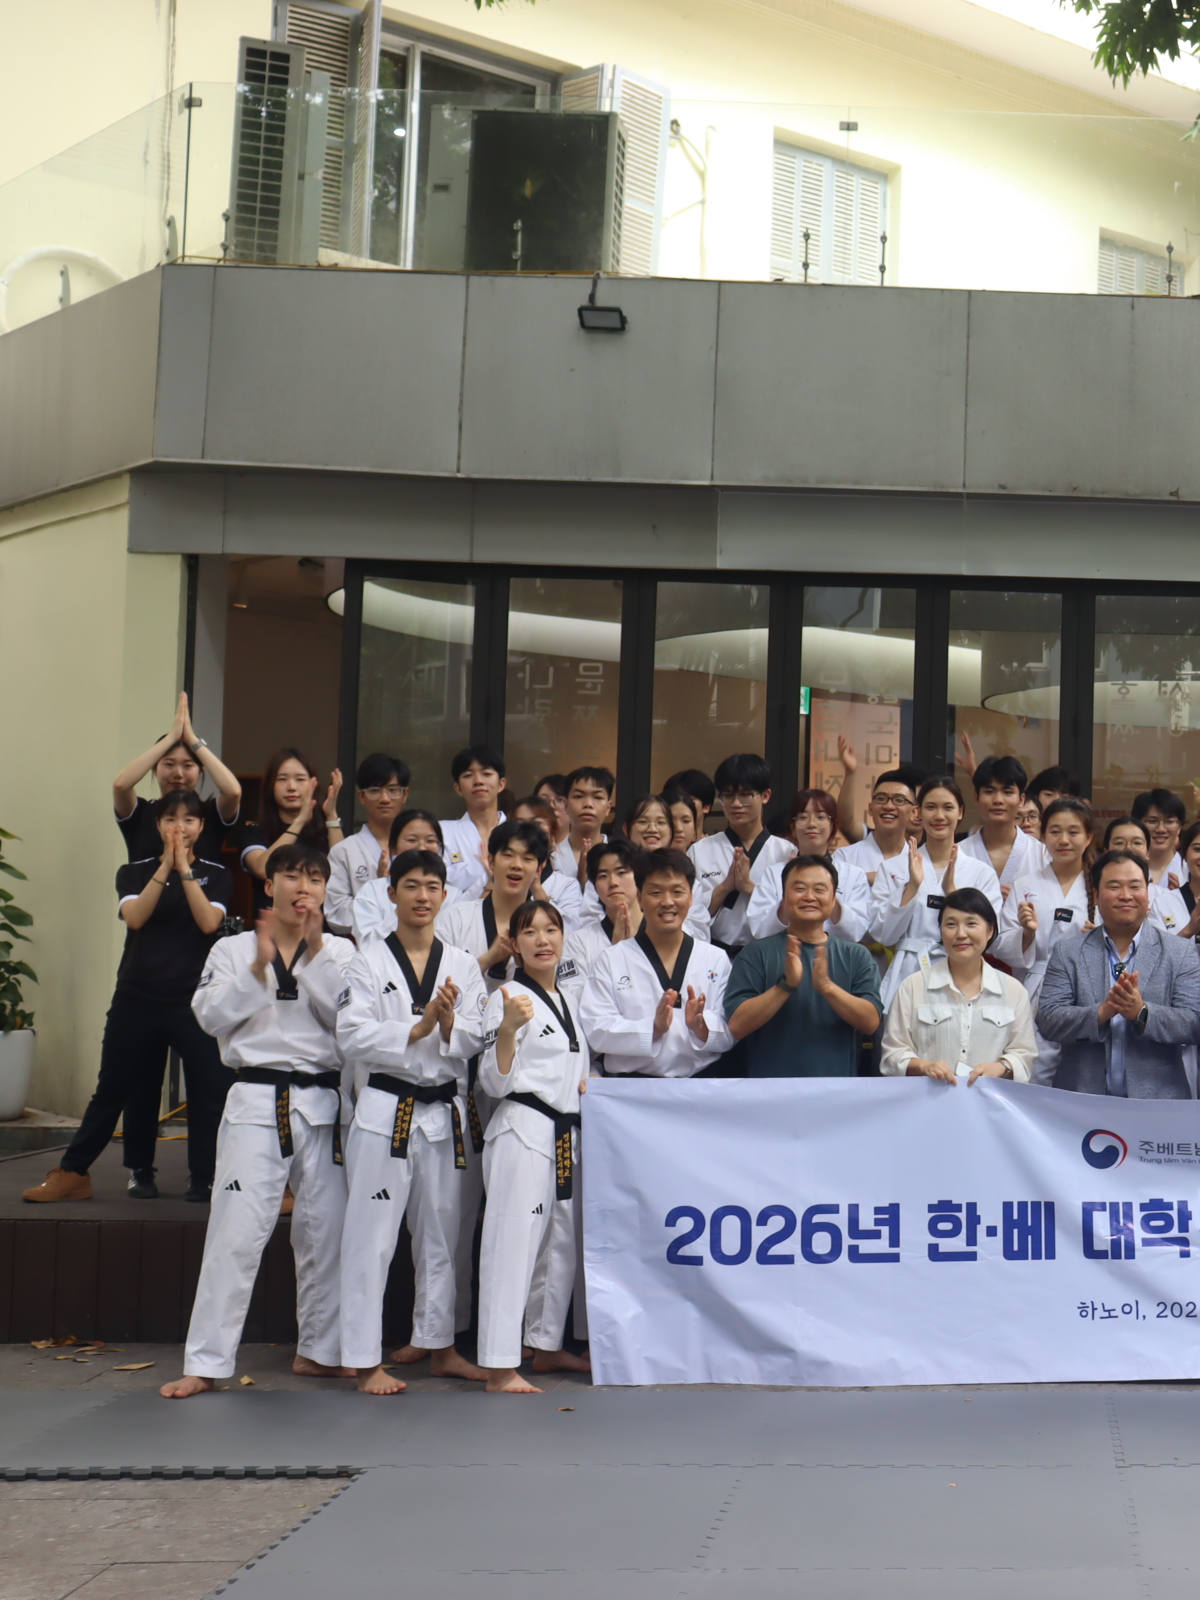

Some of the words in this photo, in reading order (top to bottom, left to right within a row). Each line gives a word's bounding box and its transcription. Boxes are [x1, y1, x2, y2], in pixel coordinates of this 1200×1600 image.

[1139, 1156, 1162, 1164] Trung
[665, 1203, 900, 1266] 2026년
[928, 1200, 1055, 1262] 한·베
[1077, 1300, 1146, 1320] 하노이,
